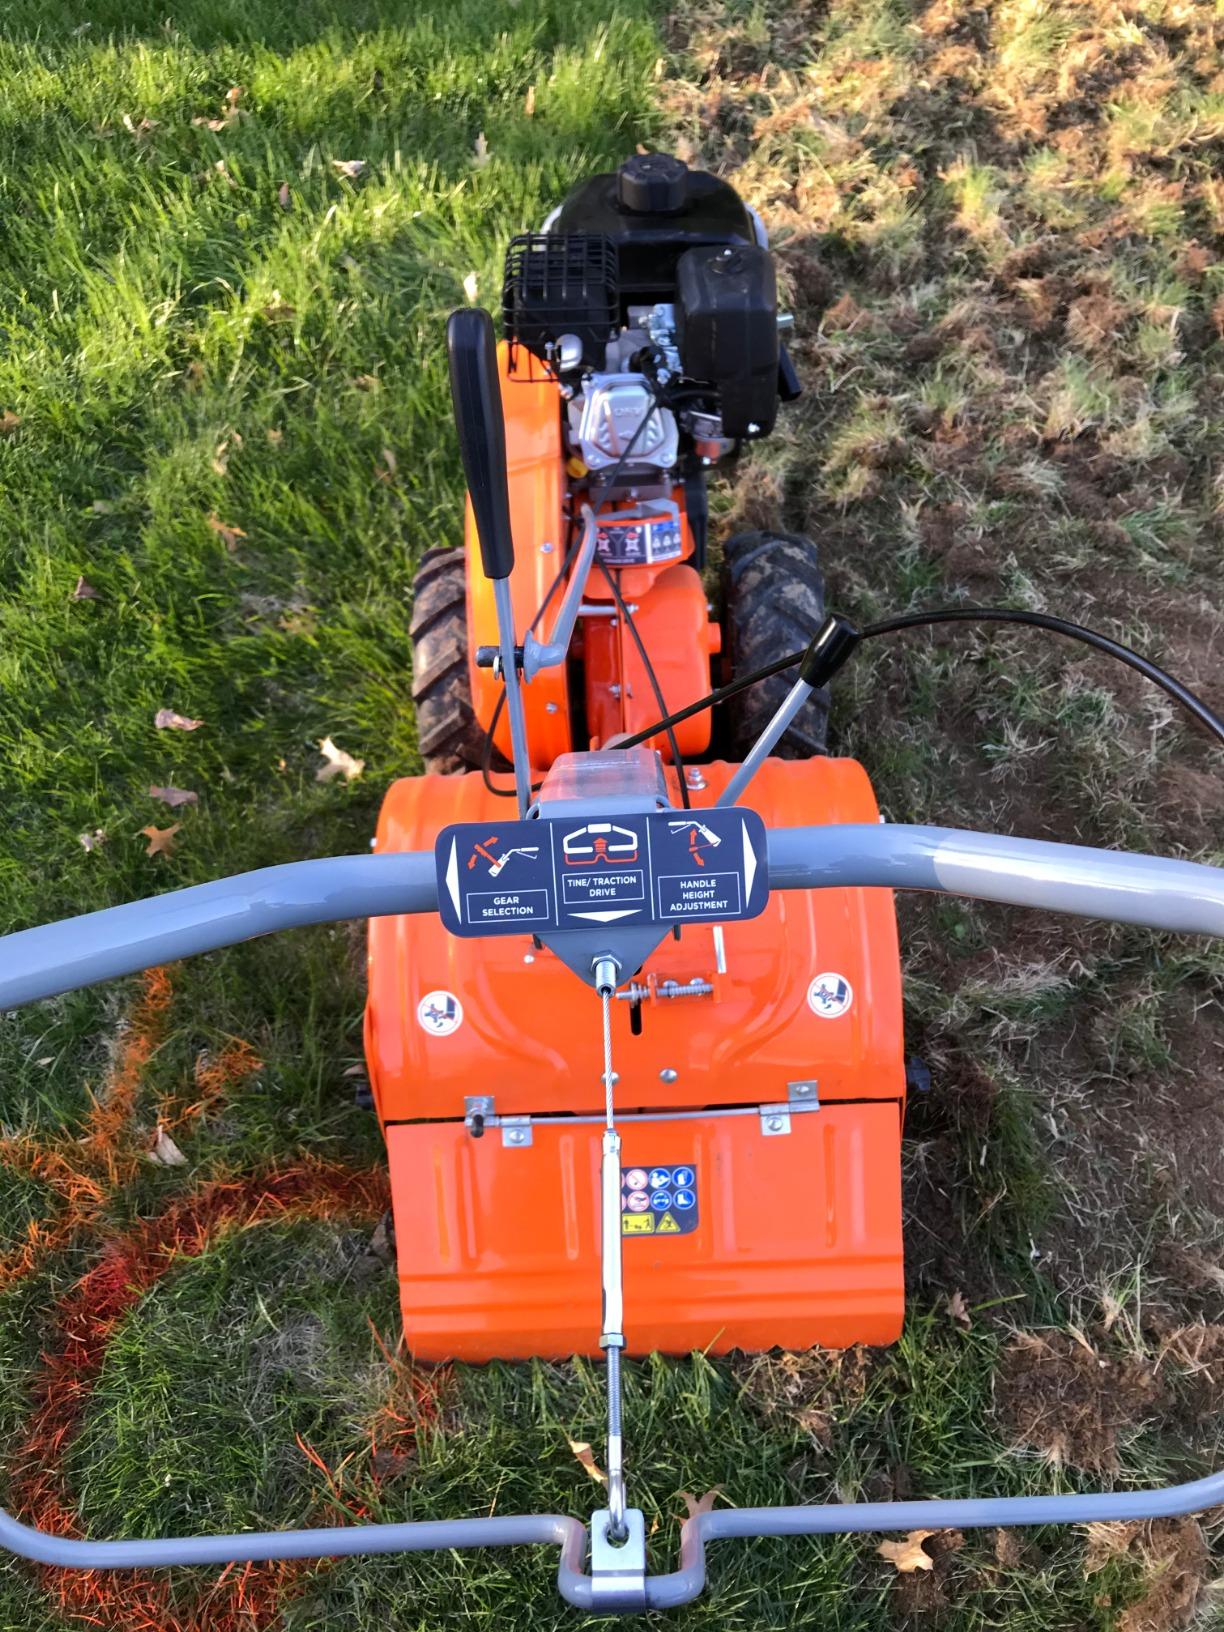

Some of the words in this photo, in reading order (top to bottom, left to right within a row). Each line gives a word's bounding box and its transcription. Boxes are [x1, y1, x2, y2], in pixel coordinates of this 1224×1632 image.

[567, 878, 591, 887] TINE/
[592, 875, 637, 886] TRACTION
[680, 879, 717, 889] HANDLE
[589, 888, 617, 897] DRIVE
[682, 890, 715, 899] HEIGHT
[493, 896, 520, 906] GEAR
[669, 901, 729, 911] ADJUSTMENT
[482, 906, 534, 917] SELECTION
